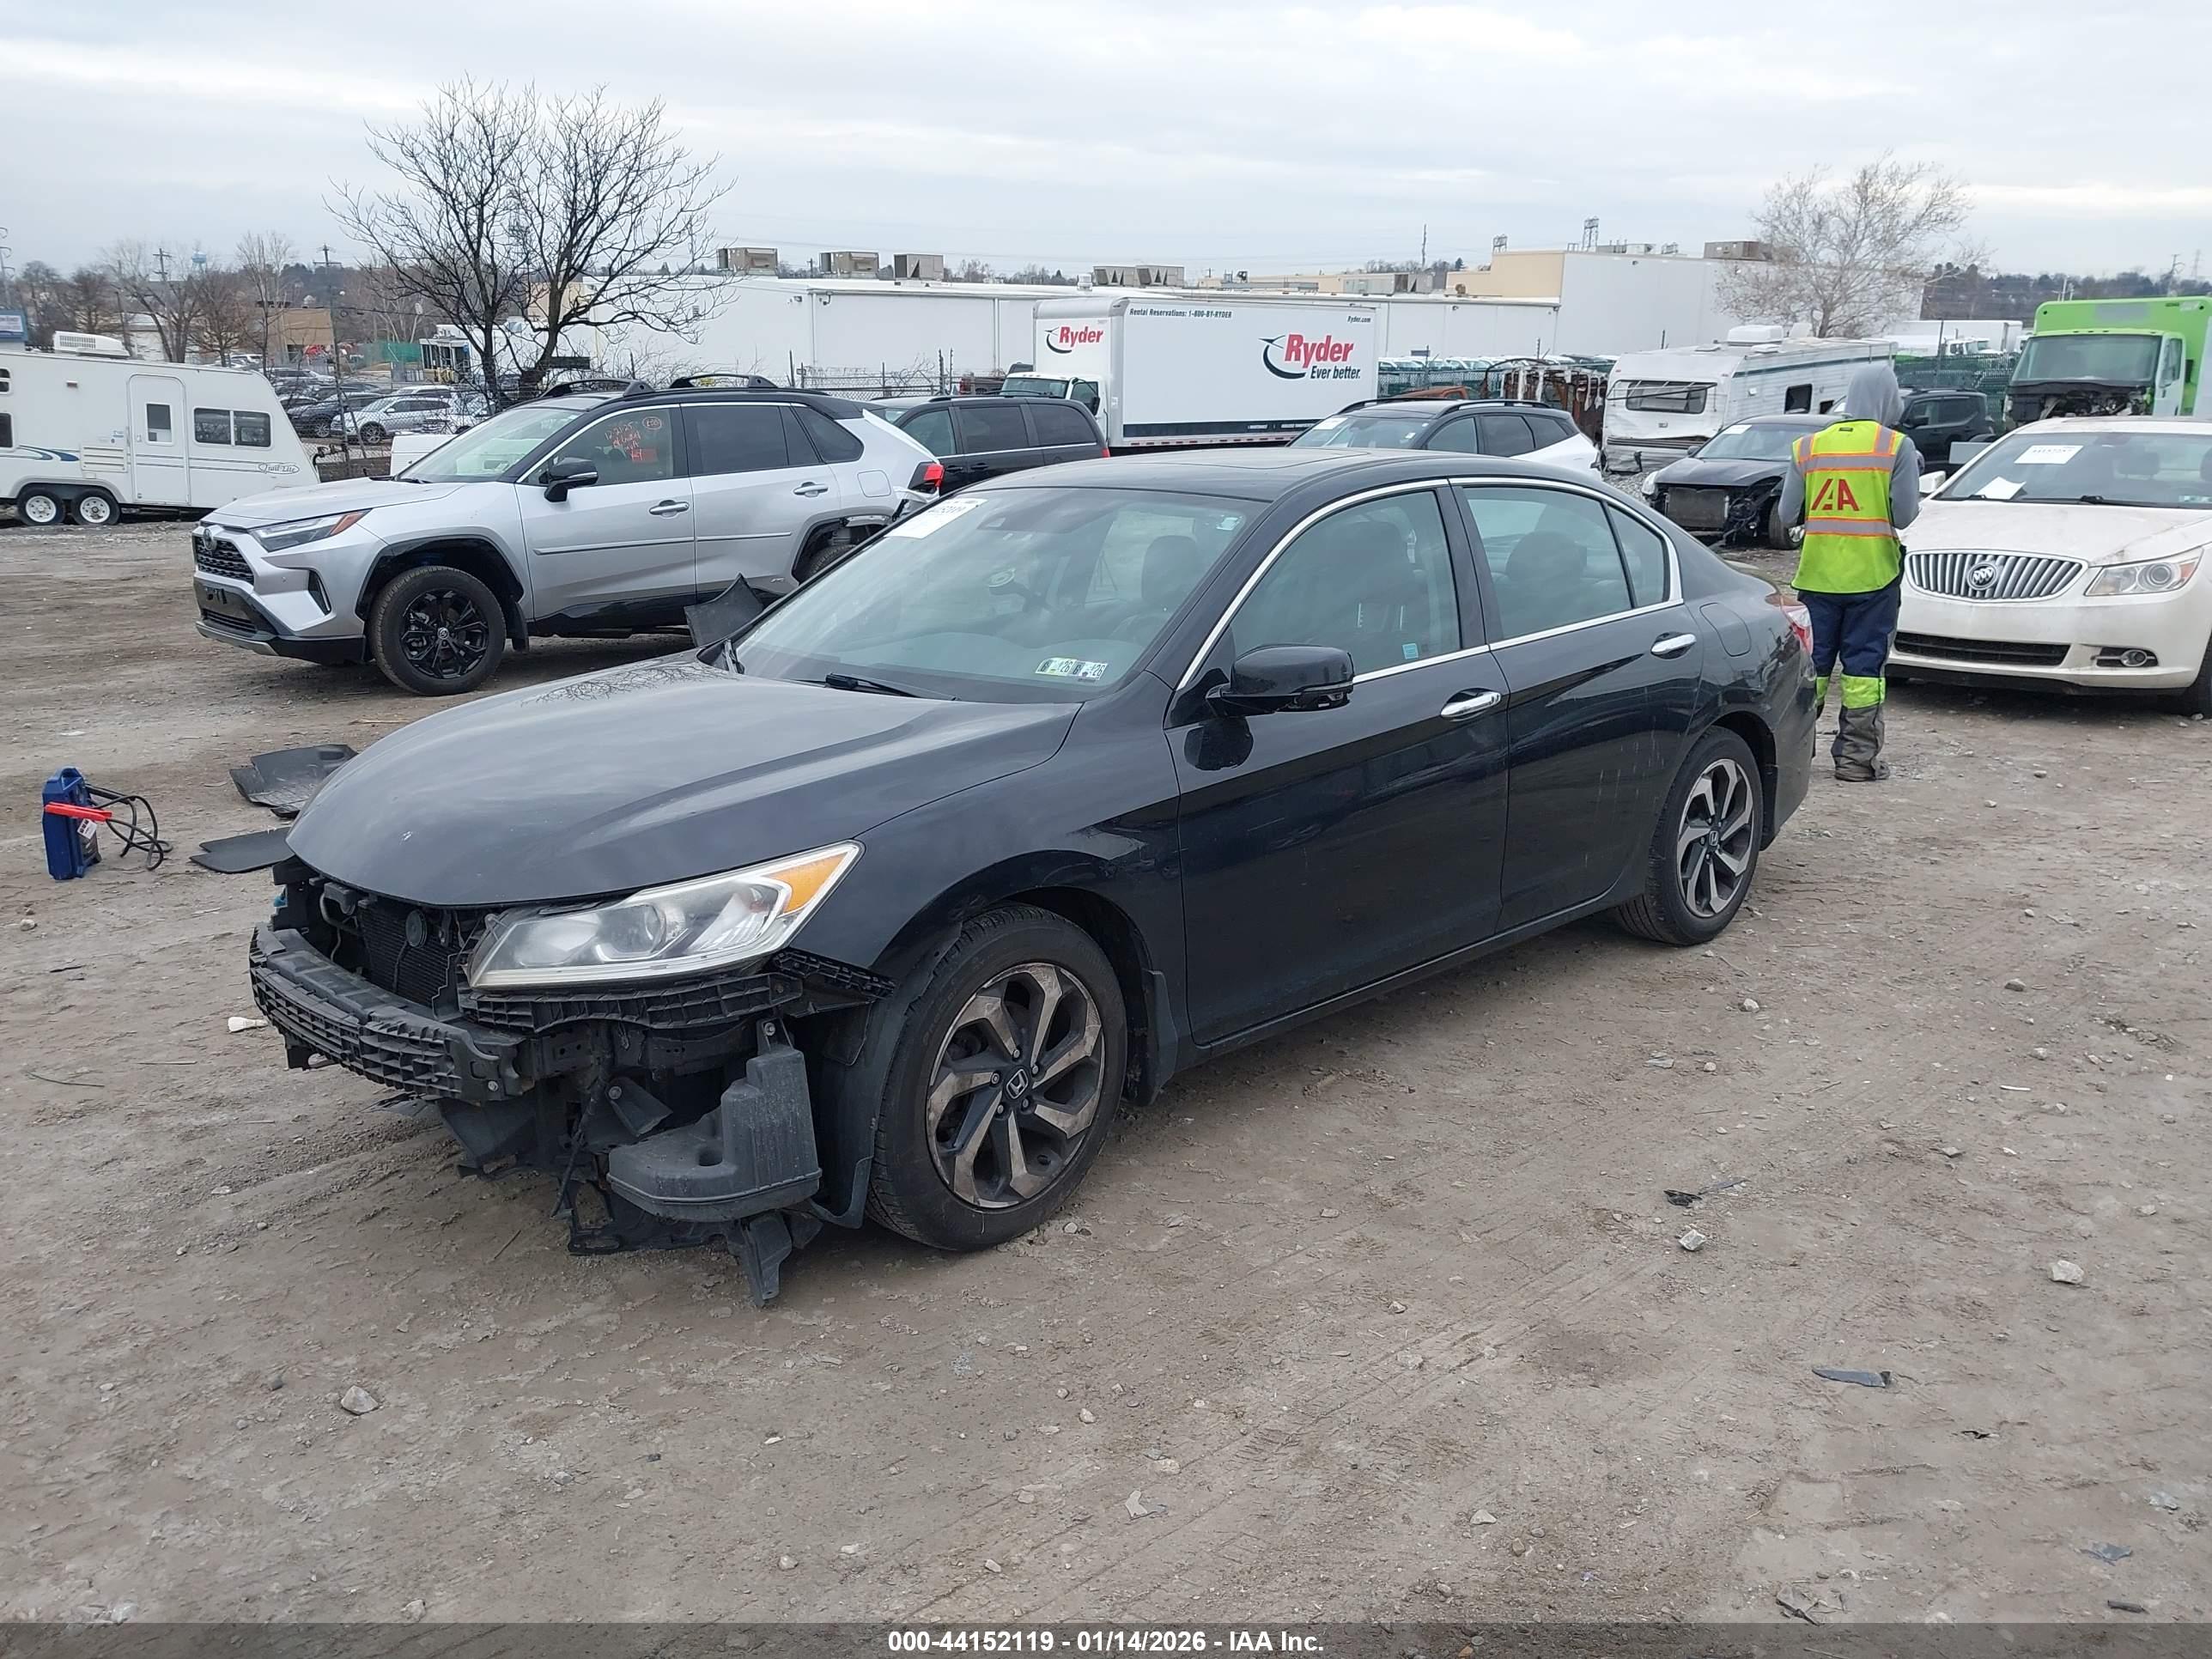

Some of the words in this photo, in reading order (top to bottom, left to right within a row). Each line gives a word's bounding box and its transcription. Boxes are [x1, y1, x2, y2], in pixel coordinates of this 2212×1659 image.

[1188, 310, 1232, 319] 1-800-BY-RYDER
[1059, 326, 1103, 347] Ryder
[1285, 334, 1354, 368] Ryder
[1310, 366, 1334, 379] Ever
[1333, 366, 1361, 379] better.
